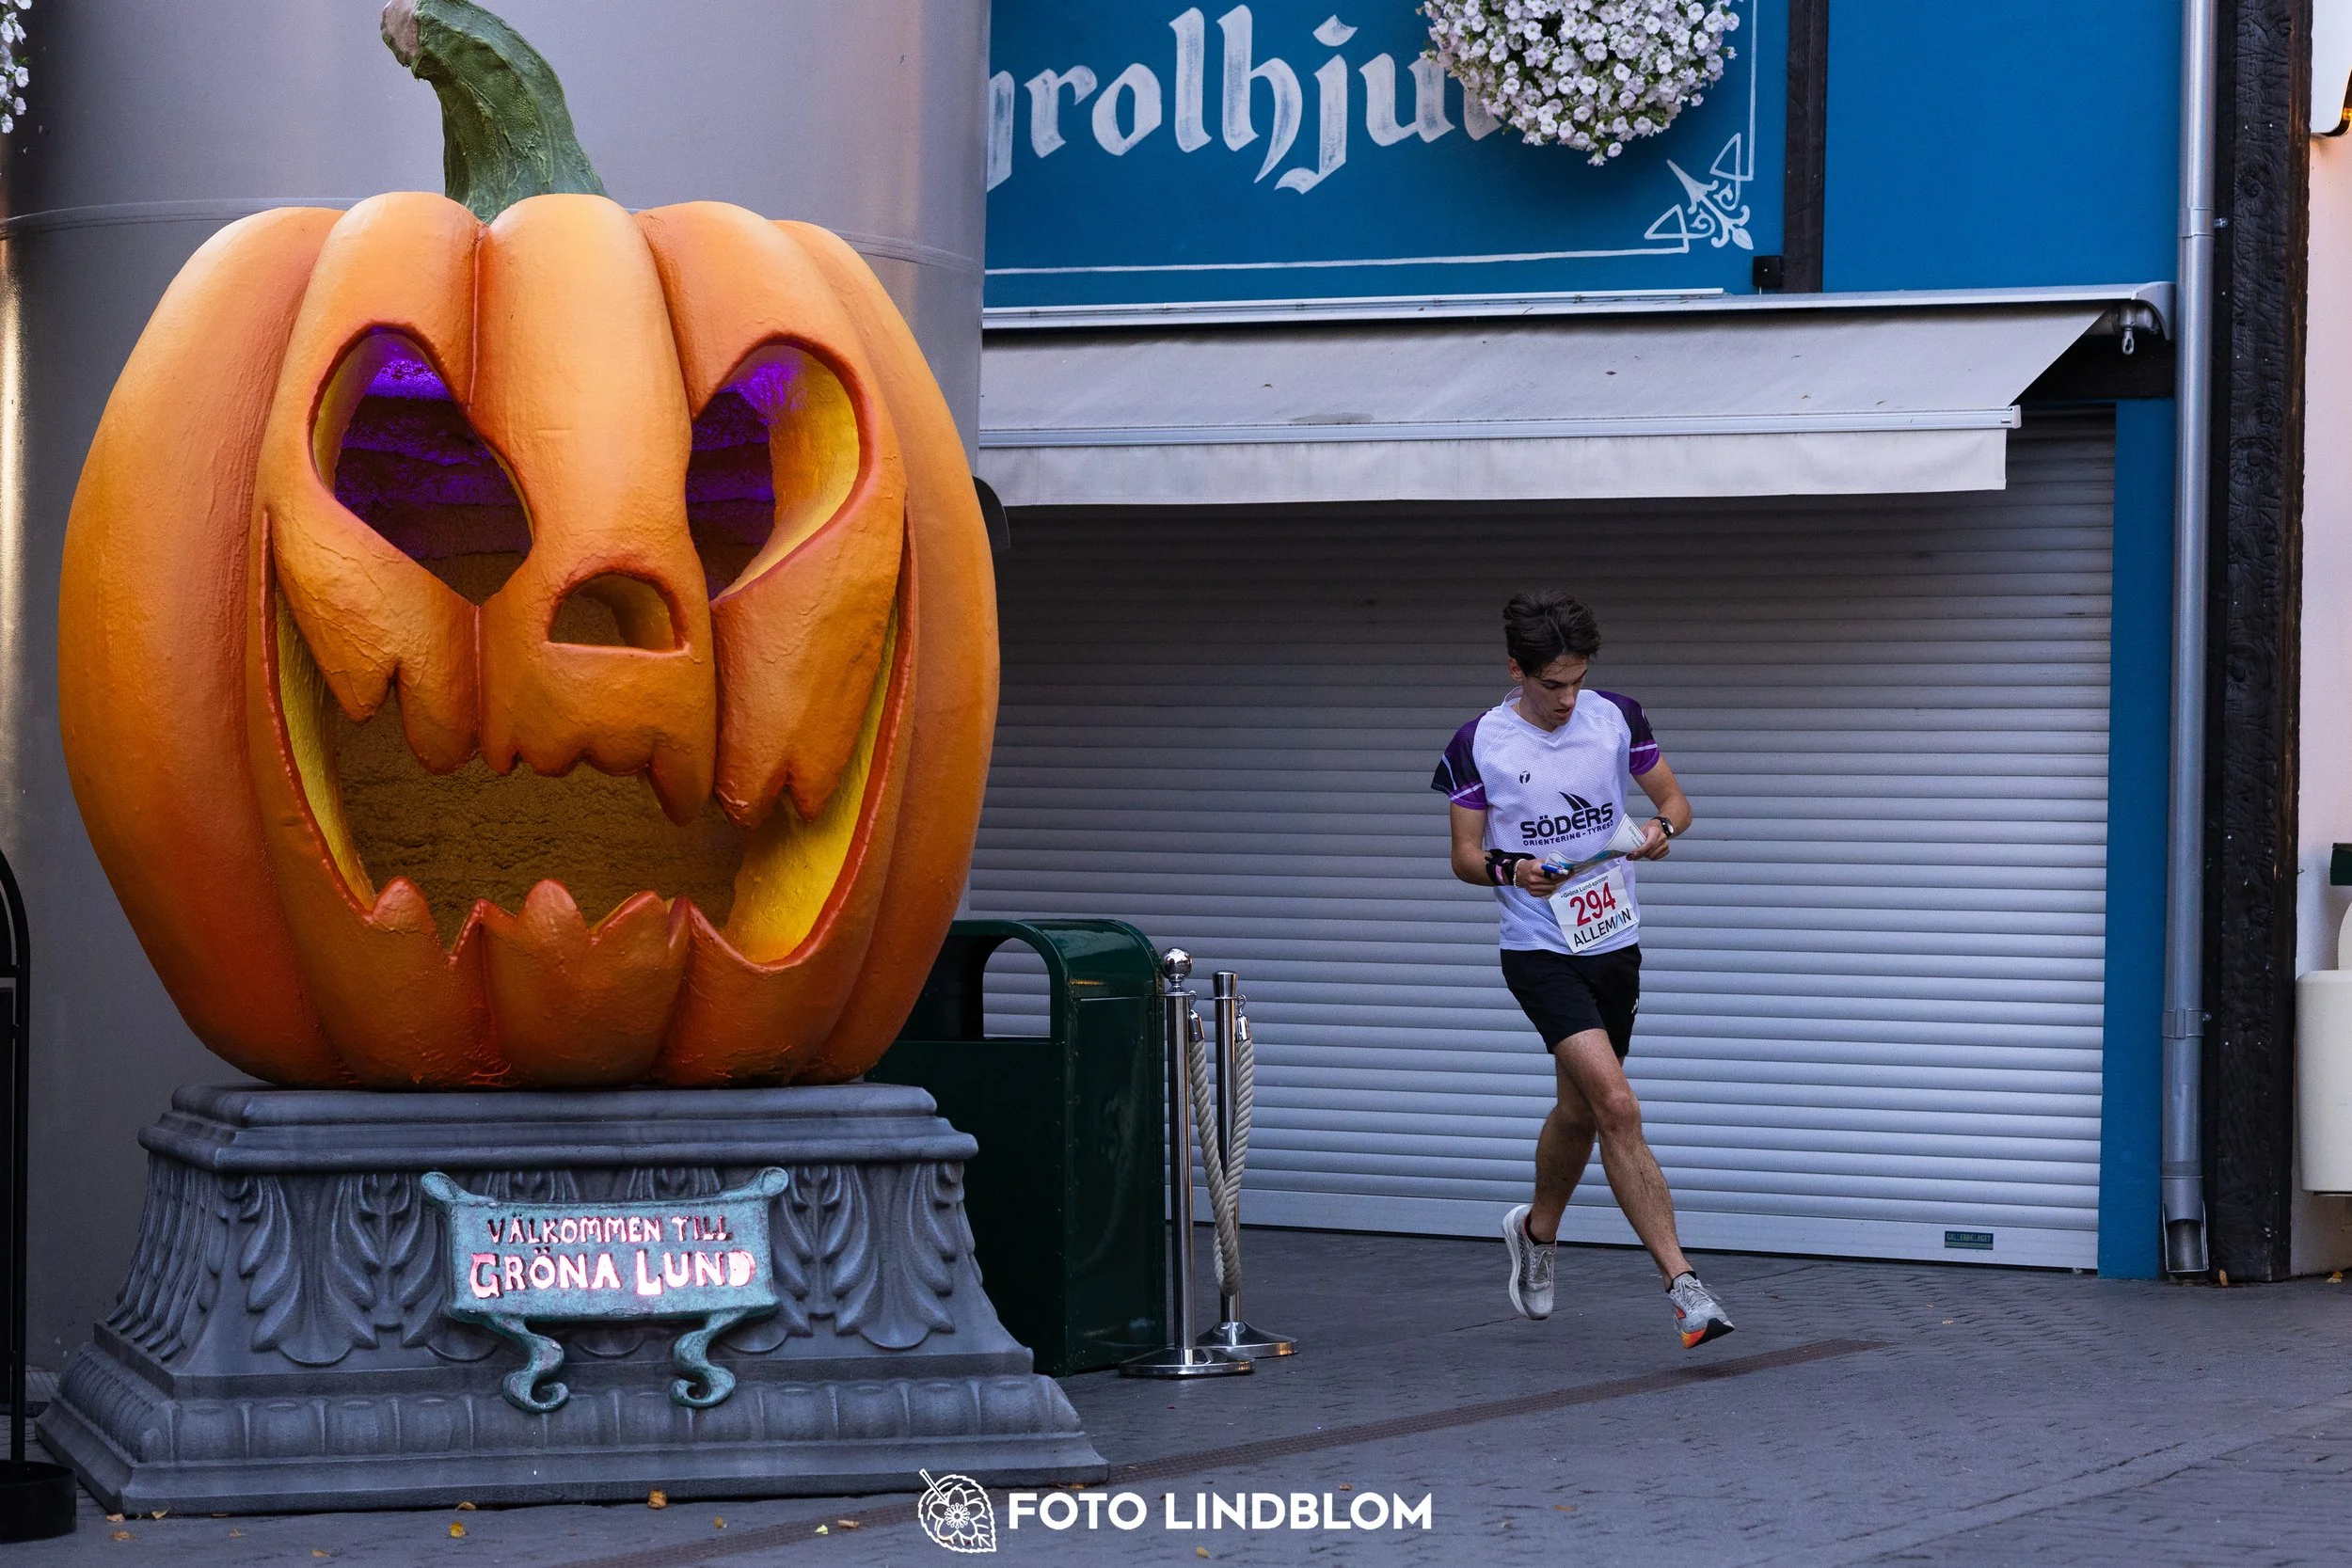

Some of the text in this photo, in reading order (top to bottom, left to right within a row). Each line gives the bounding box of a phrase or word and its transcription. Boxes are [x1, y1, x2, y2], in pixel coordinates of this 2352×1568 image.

[1520, 802, 1613, 839] SÖDERS
[1569, 882, 1616, 927] 294
[486, 1212, 733, 1244] VÄLKOMMEN TILL
[470, 1247, 756, 1299] GRÖNA LUND
